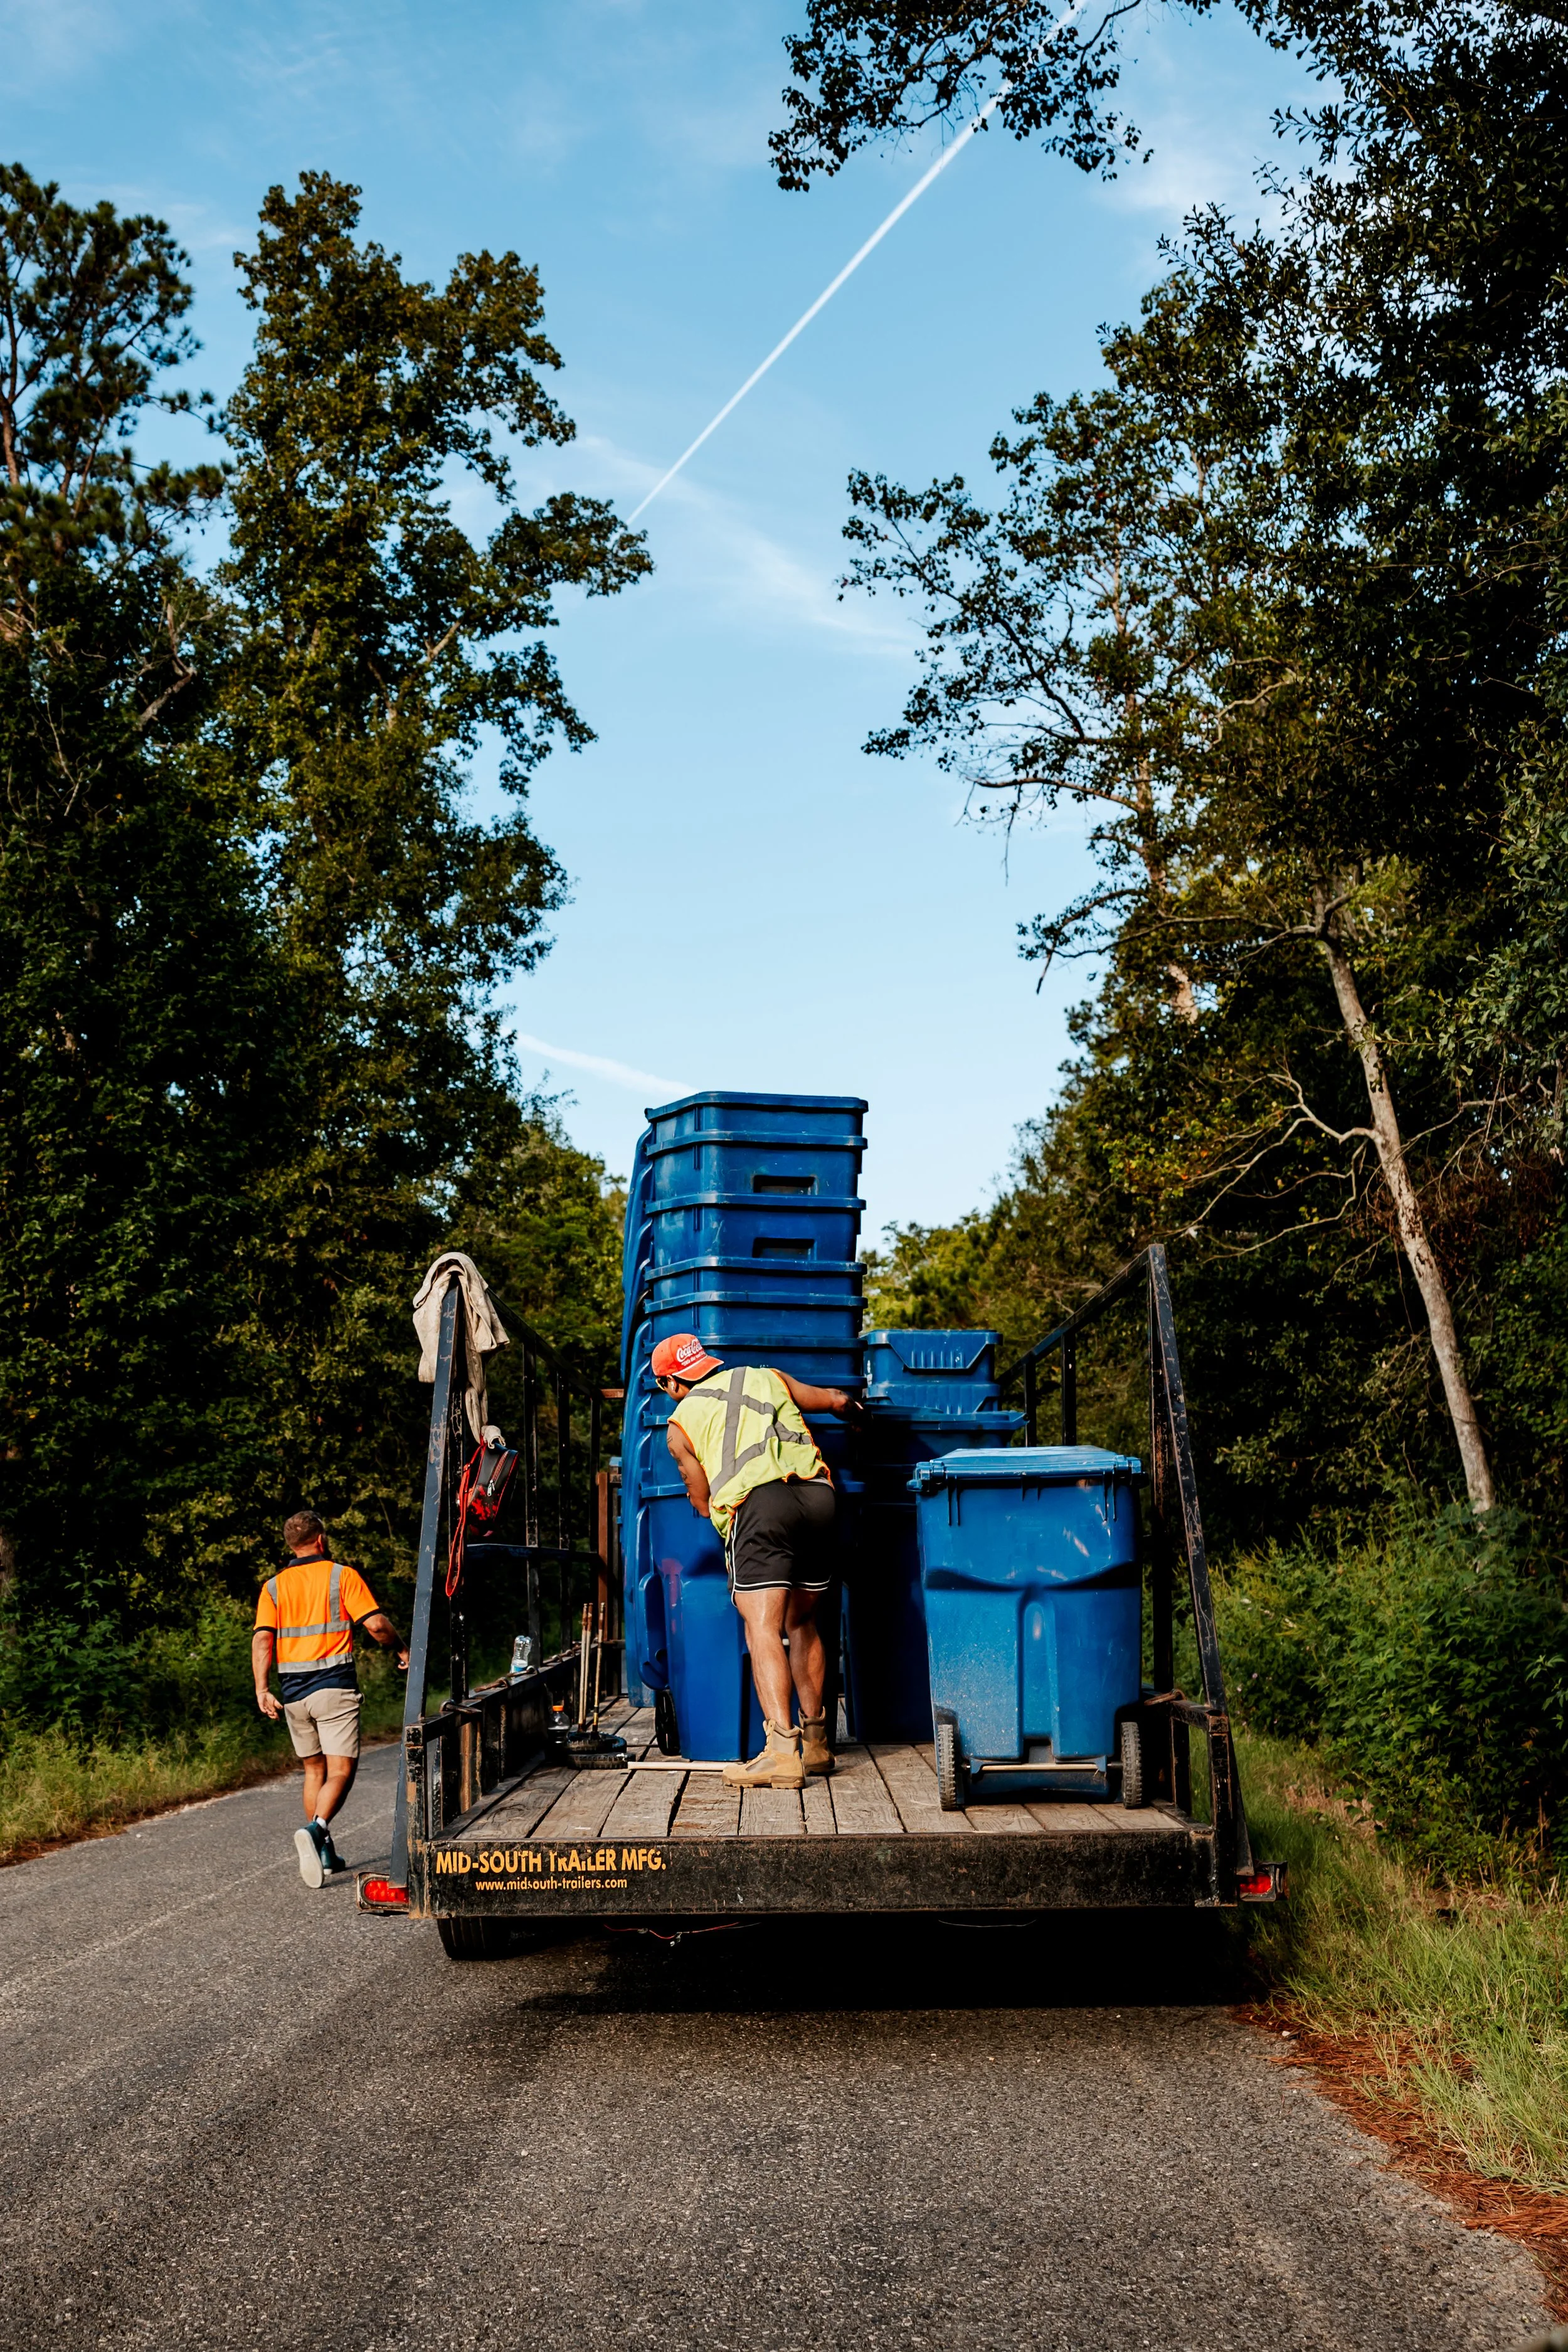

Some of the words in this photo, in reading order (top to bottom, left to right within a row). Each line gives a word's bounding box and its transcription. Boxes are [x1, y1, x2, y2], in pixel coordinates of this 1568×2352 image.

[436, 1850, 542, 1873] MID-SOUTH
[621, 1848, 667, 1871] MFG.
[475, 1875, 627, 1890] www.midsouth-trailers.com
